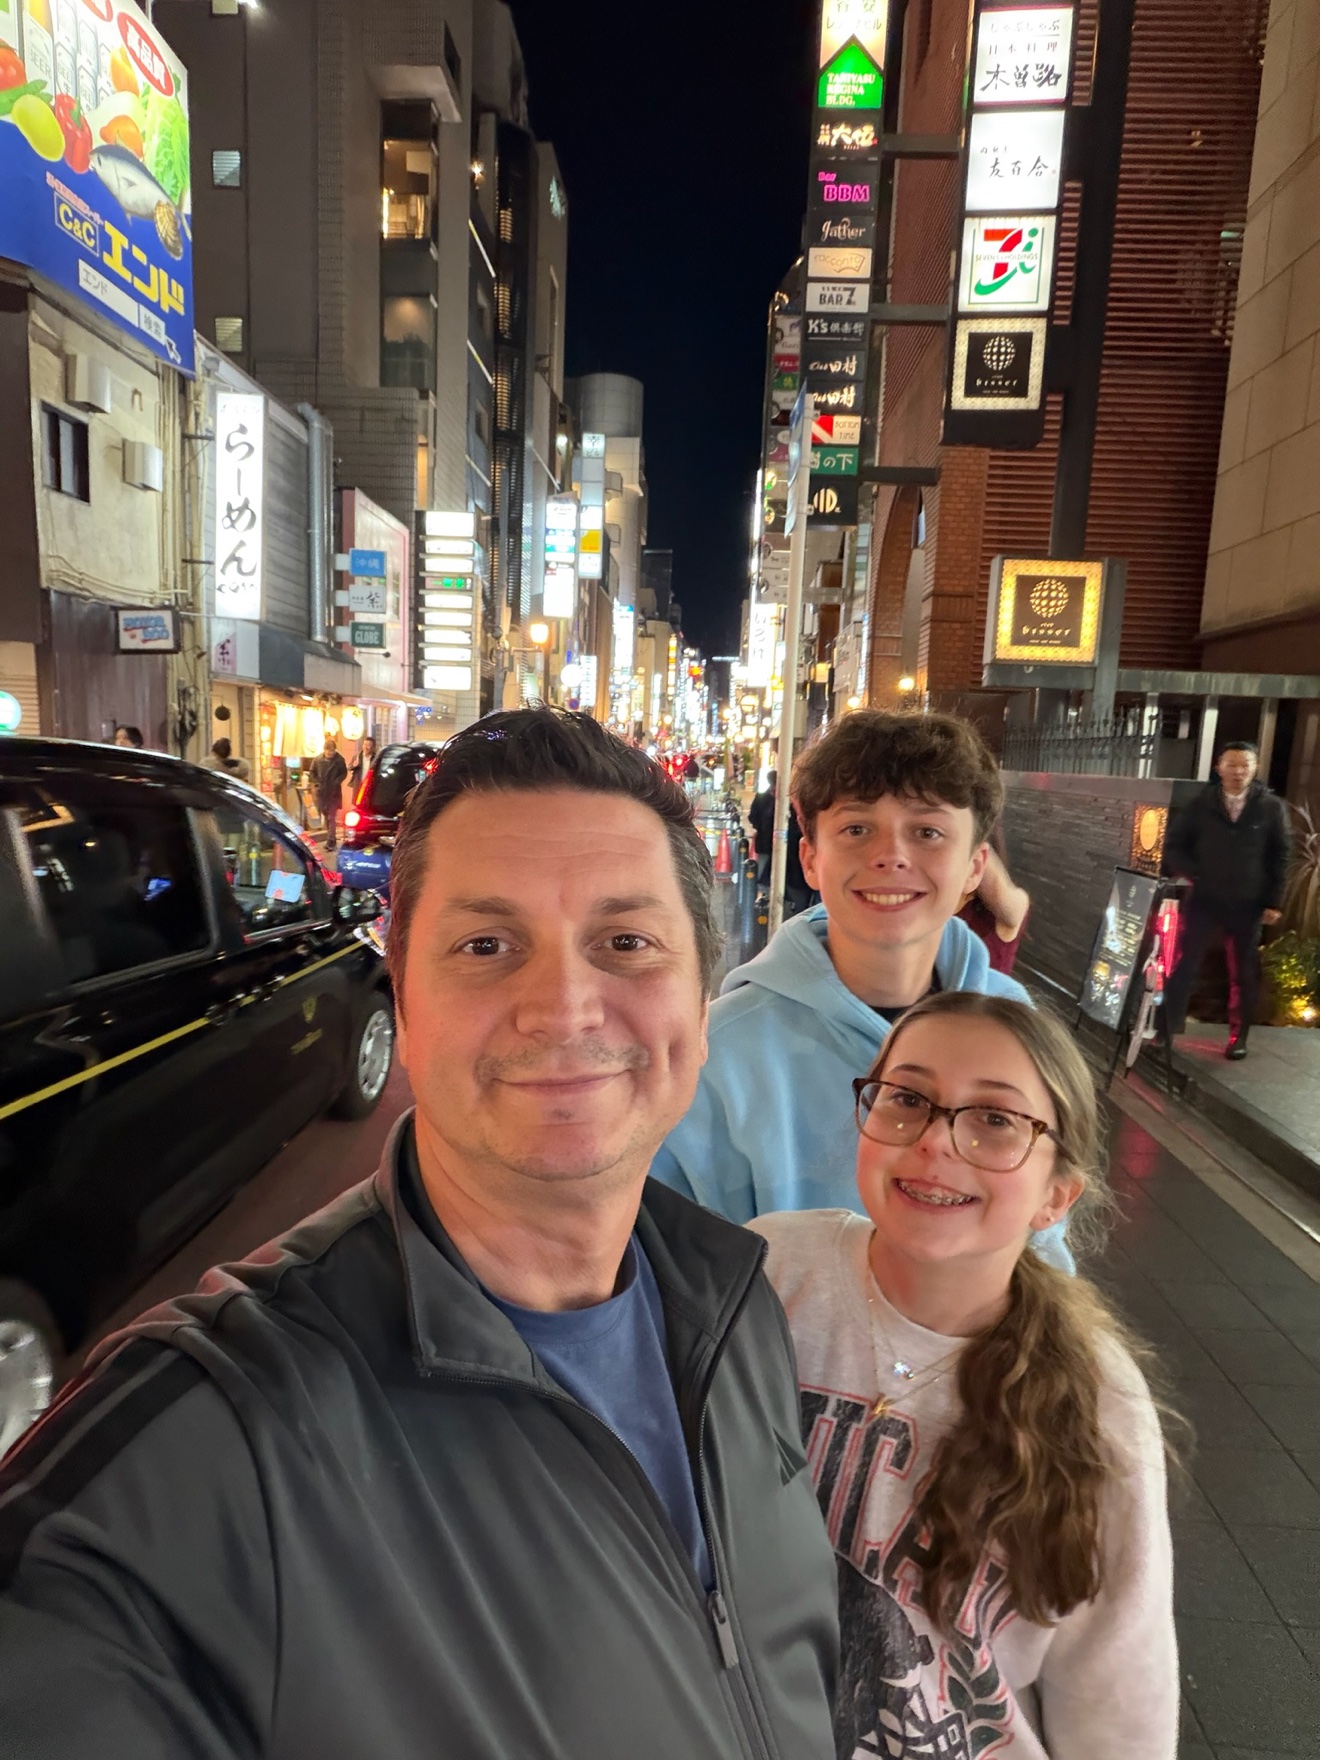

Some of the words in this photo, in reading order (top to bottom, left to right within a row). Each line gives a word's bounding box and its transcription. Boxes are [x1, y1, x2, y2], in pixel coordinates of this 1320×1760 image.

[980, 64, 1062, 91] 木曽路
[824, 184, 870, 202] BBM
[59, 203, 96, 247] C&C
[82, 268, 108, 295] エンド
[103, 221, 185, 316] エンド
[819, 293, 843, 305] BAR
[220, 423, 257, 576] らーめん
